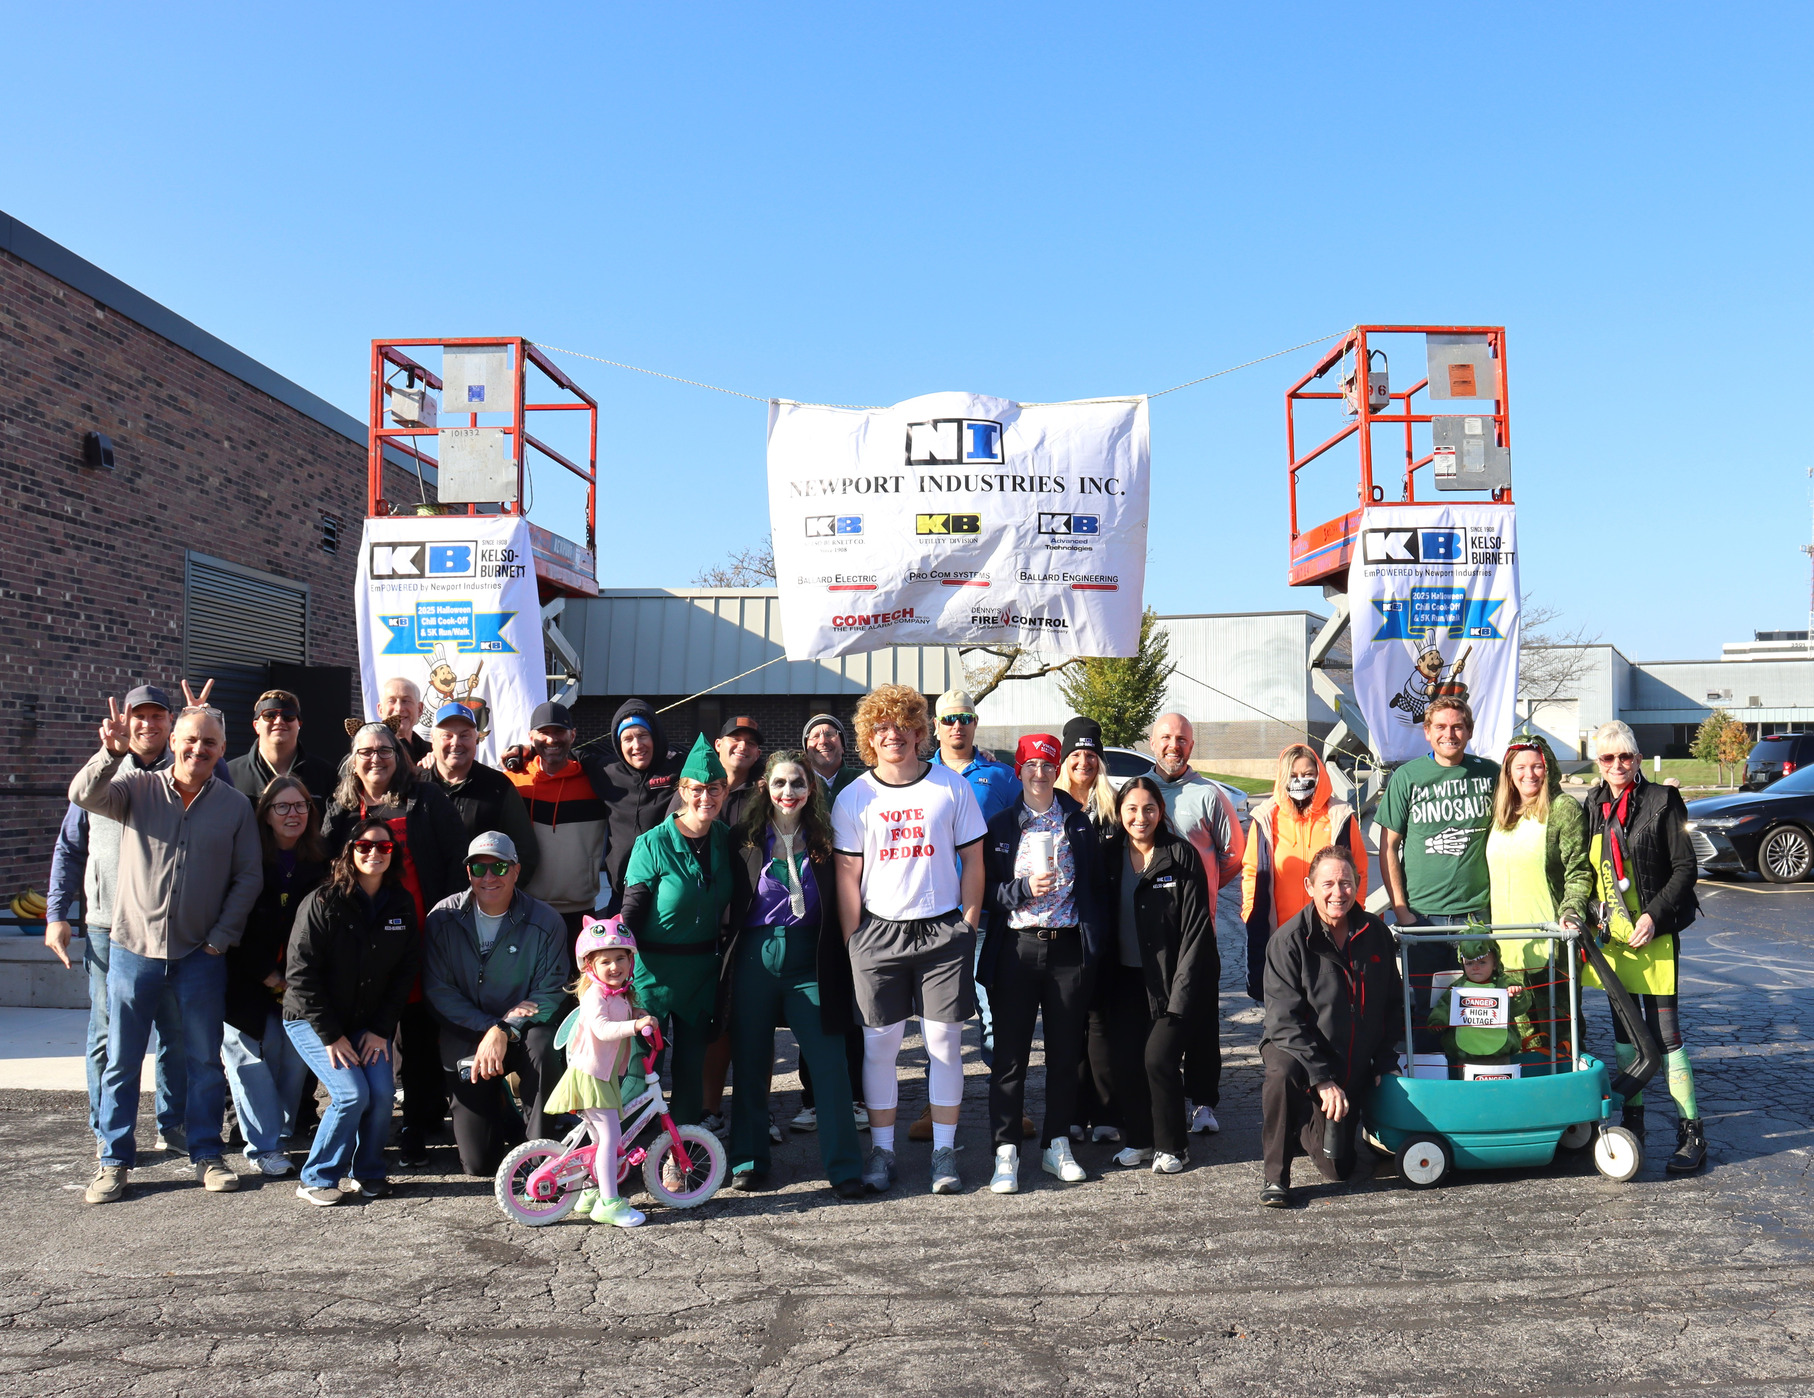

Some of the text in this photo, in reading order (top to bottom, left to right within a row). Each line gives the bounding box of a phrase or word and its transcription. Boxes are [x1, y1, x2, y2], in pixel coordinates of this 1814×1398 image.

[451, 429, 480, 437] 101332
[909, 420, 999, 462] NI
[790, 474, 1126, 498] NEWPORT INDUSTRIES INC.
[806, 515, 863, 535] KB
[916, 514, 980, 534] KB
[1039, 514, 1099, 534] KB
[1045, 544, 1093, 552] Technologies
[1365, 530, 1463, 561] KB
[1470, 536, 1506, 550] KELSO-
[372, 545, 473, 576] KB
[480, 549, 519, 562] KELSO-
[1471, 551, 1516, 565] BURNETT
[480, 564, 526, 578] BURNETT
[910, 572, 928, 580] PRO
[930, 571, 951, 579] COM
[1020, 572, 1119, 582] BALLARD ENGINEERING
[1364, 568, 1492, 578] EmPOWERED by Newport Industries
[835, 573, 877, 583] ELECTRIC
[370, 582, 502, 592] EmPOWERED by Newport Industries
[1412, 591, 1464, 600] 2025 Halloween
[417, 606, 471, 615] 2025 Halloween
[971, 606, 1002, 614] DENNY'S
[1415, 602, 1460, 611] Chili Cook-Off
[421, 616, 468, 626] Chili Cook-Off
[832, 607, 915, 627] CONTECH
[971, 615, 1069, 628] FIRE CONTROL
[420, 627, 470, 637] & 5K Run/Walk
[868, 622, 893, 631] ALARM
[1411, 777, 1493, 804] I'M WITH THE
[879, 808, 924, 823] VOTE
[1411, 795, 1493, 824] DINOSAUR
[891, 826, 924, 841] FOR
[879, 844, 935, 861] PEDRO
[1601, 859, 1619, 908] GRINCH
[1462, 1016, 1495, 1025] VOLTAGE
